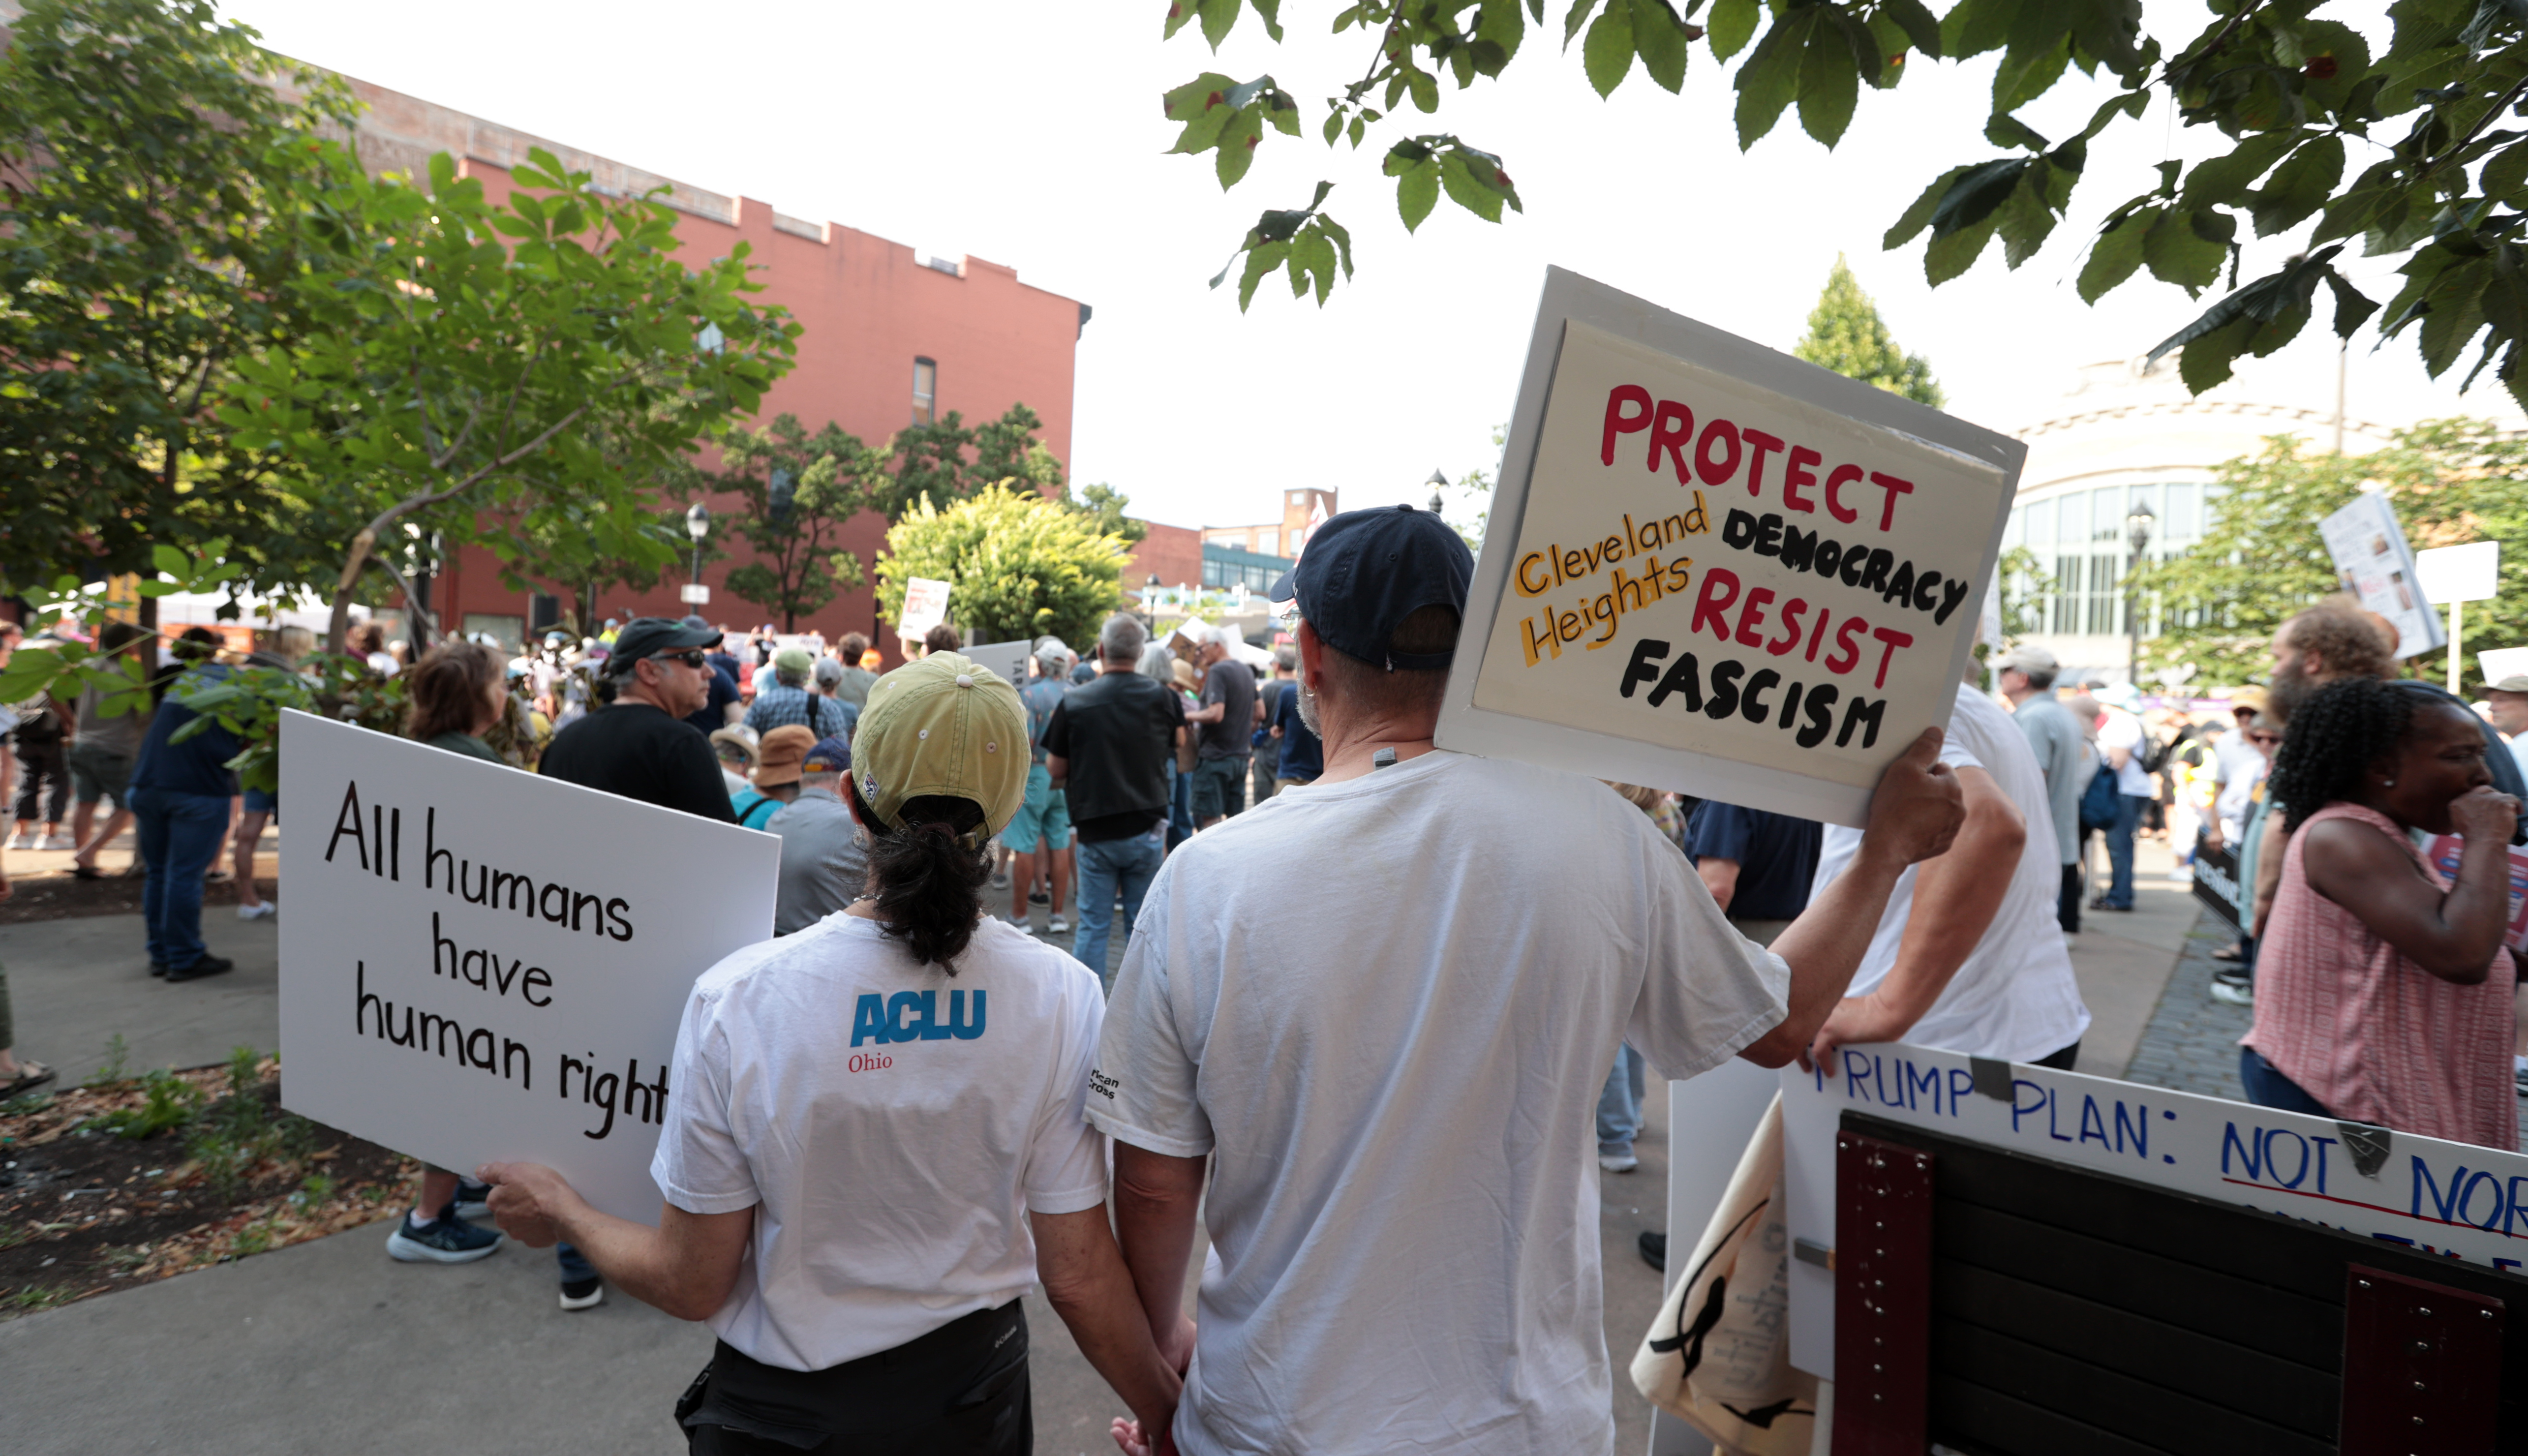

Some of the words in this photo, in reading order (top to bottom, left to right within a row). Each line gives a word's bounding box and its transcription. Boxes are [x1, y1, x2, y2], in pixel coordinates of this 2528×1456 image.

[1601, 384, 1914, 532] PROTECT
[1514, 490, 1711, 598] Cleveland
[1722, 508, 1968, 626] DEMOCRACY
[1520, 555, 1693, 668] Heights
[1692, 568, 1913, 689] RESIST
[1012, 658, 1023, 692] TAR
[1620, 638, 1886, 749] FASCISM
[325, 780, 400, 881] All
[426, 806, 633, 942] humans
[432, 911, 552, 1007] have
[357, 960, 531, 1091] human
[560, 1051, 669, 1140] right
[849, 1054, 892, 1073] Ohio
[850, 990, 986, 1048] ACLU
[2011, 1080, 2177, 1164] PLAN:
[2221, 1122, 2339, 1194] NOT
